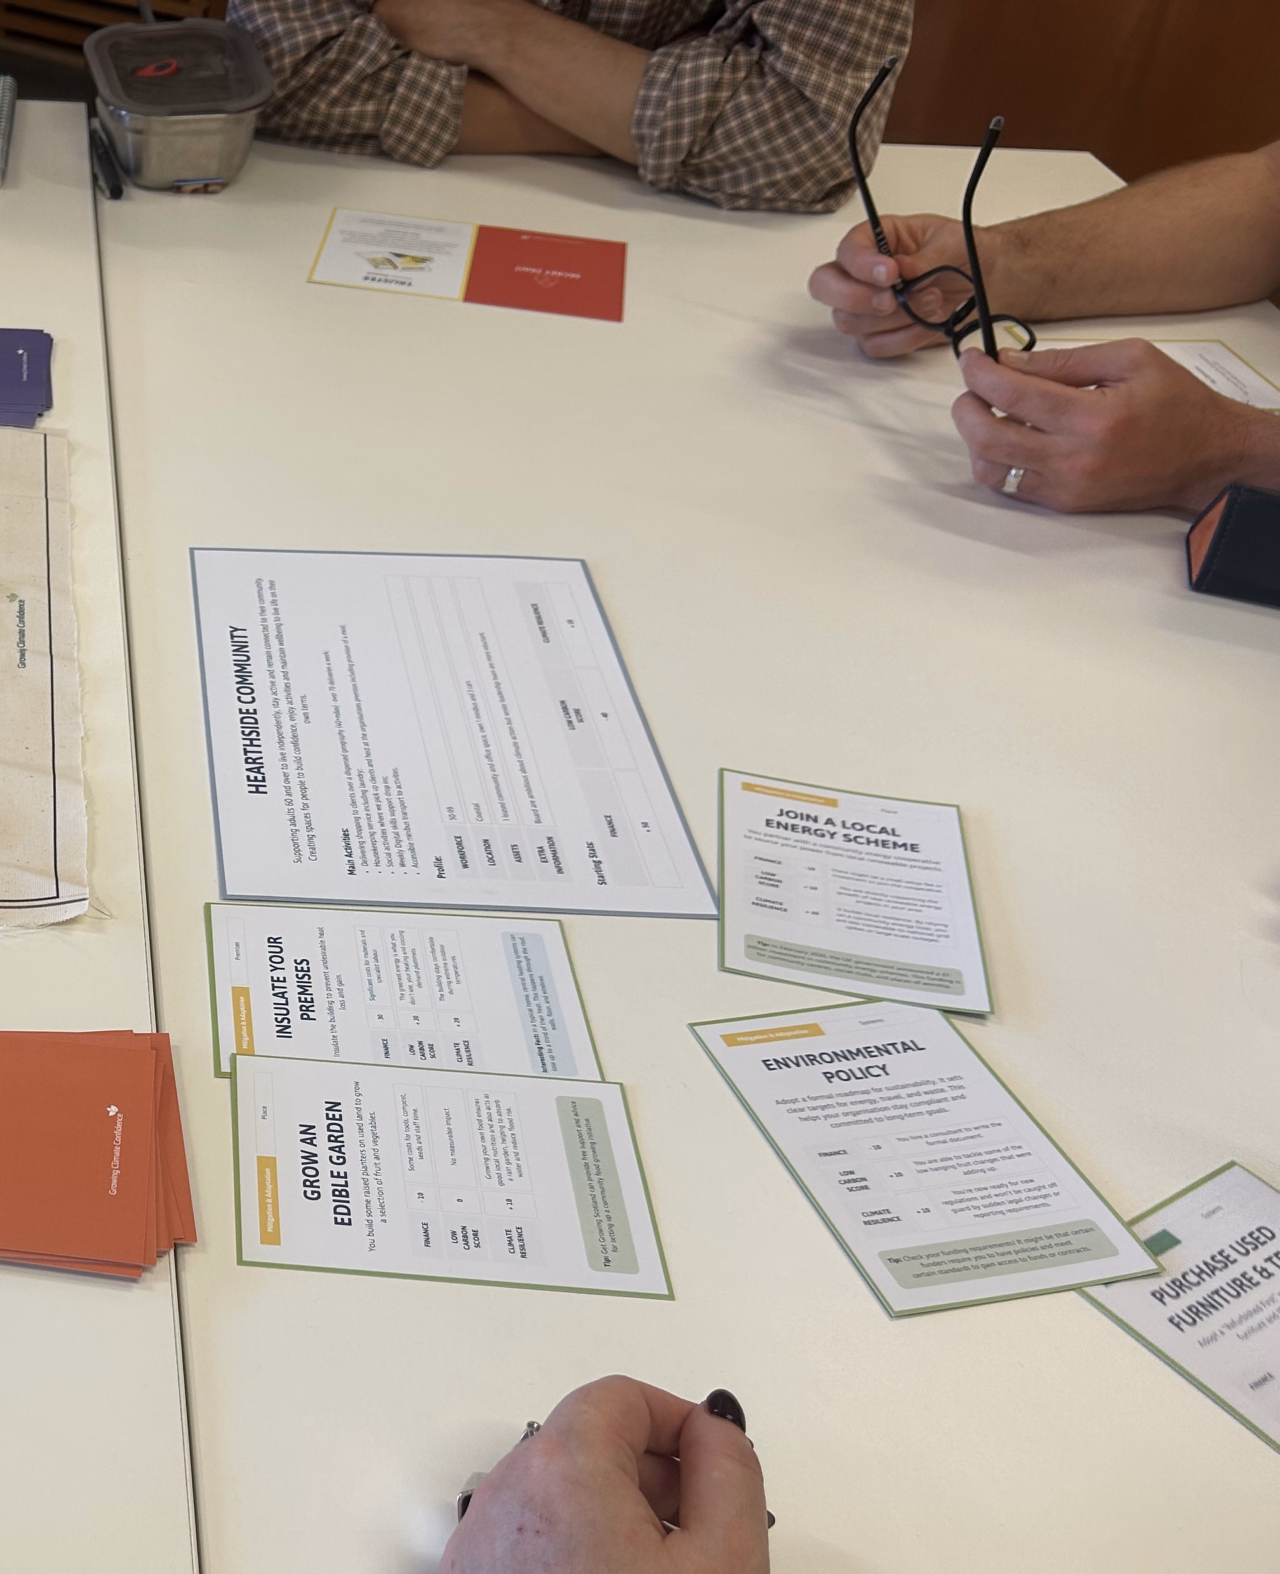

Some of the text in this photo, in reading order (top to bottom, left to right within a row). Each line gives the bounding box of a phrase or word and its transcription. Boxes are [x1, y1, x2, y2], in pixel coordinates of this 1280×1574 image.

[13, 598, 26, 628] Confidence
[16, 627, 26, 648] Climate
[228, 624, 268, 794] HEARTHSIDE COMMUNITY
[277, 751, 287, 762] live
[282, 770, 291, 784] over
[282, 784, 293, 797] and
[285, 807, 297, 827] adults
[776, 808, 901, 837] JOIN A LOCAL
[290, 827, 303, 863] Supporting
[765, 818, 838, 840] ENERGY
[842, 832, 920, 853] SCHEME
[453, 834, 469, 869] WORKFORCE
[481, 838, 496, 866] LOCATION
[345, 858, 357, 875] Main
[591, 859, 607, 885] Starting
[266, 936, 292, 1038] INSULATE YOUR
[293, 958, 316, 1020] PREMISES
[760, 1039, 926, 1071] ENVIRONMENTAL
[821, 1063, 890, 1084] POLICY
[260, 1105, 268, 1120] Place
[367, 1110, 380, 1146] vegetables.
[108, 1112, 124, 1195] Growing Climate Confidence
[298, 1123, 321, 1201] GROW AN
[324, 1100, 352, 1226] EDIBLE GARDEN
[353, 1080, 376, 1252] You build some raised planters on used land to grow
[370, 1147, 380, 1160] and
[372, 1161, 382, 1176] fruit
[373, 1176, 383, 1185] of
[376, 1186, 386, 1217] selection
[420, 1221, 431, 1247] FINANCE
[449, 1229, 458, 1243] LOW
[460, 1225, 470, 1250] CARBON
[471, 1228, 481, 1248] SCORE
[504, 1228, 516, 1254] CLIMATE
[514, 1225, 527, 1258] RESILIENCE
[1150, 1225, 1280, 1306] PURCHASE USED
[1167, 1264, 1275, 1333] FURNITURE &
